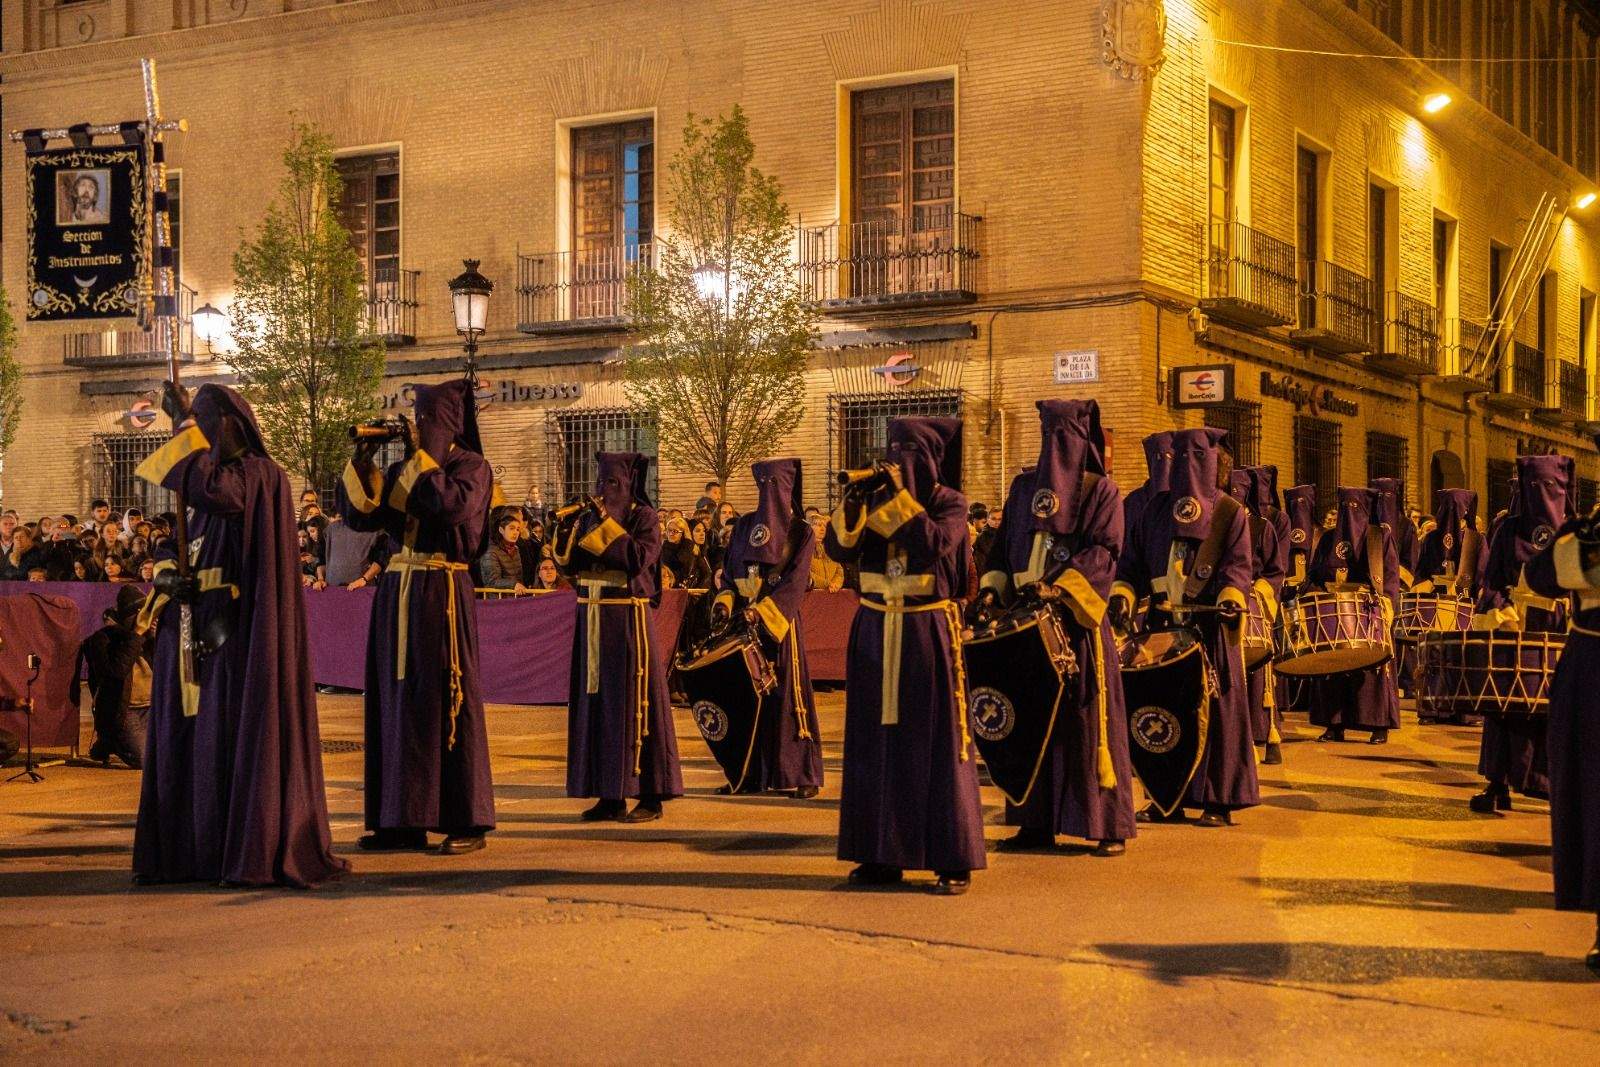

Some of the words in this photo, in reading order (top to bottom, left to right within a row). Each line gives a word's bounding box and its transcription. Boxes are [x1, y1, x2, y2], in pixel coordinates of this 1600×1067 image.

[80, 243, 92, 254] de
[48, 254, 122, 268] Instrumentos
[1072, 355, 1092, 363] PLAZA
[1069, 363, 1079, 371] DE
[496, 379, 582, 402] Huesca
